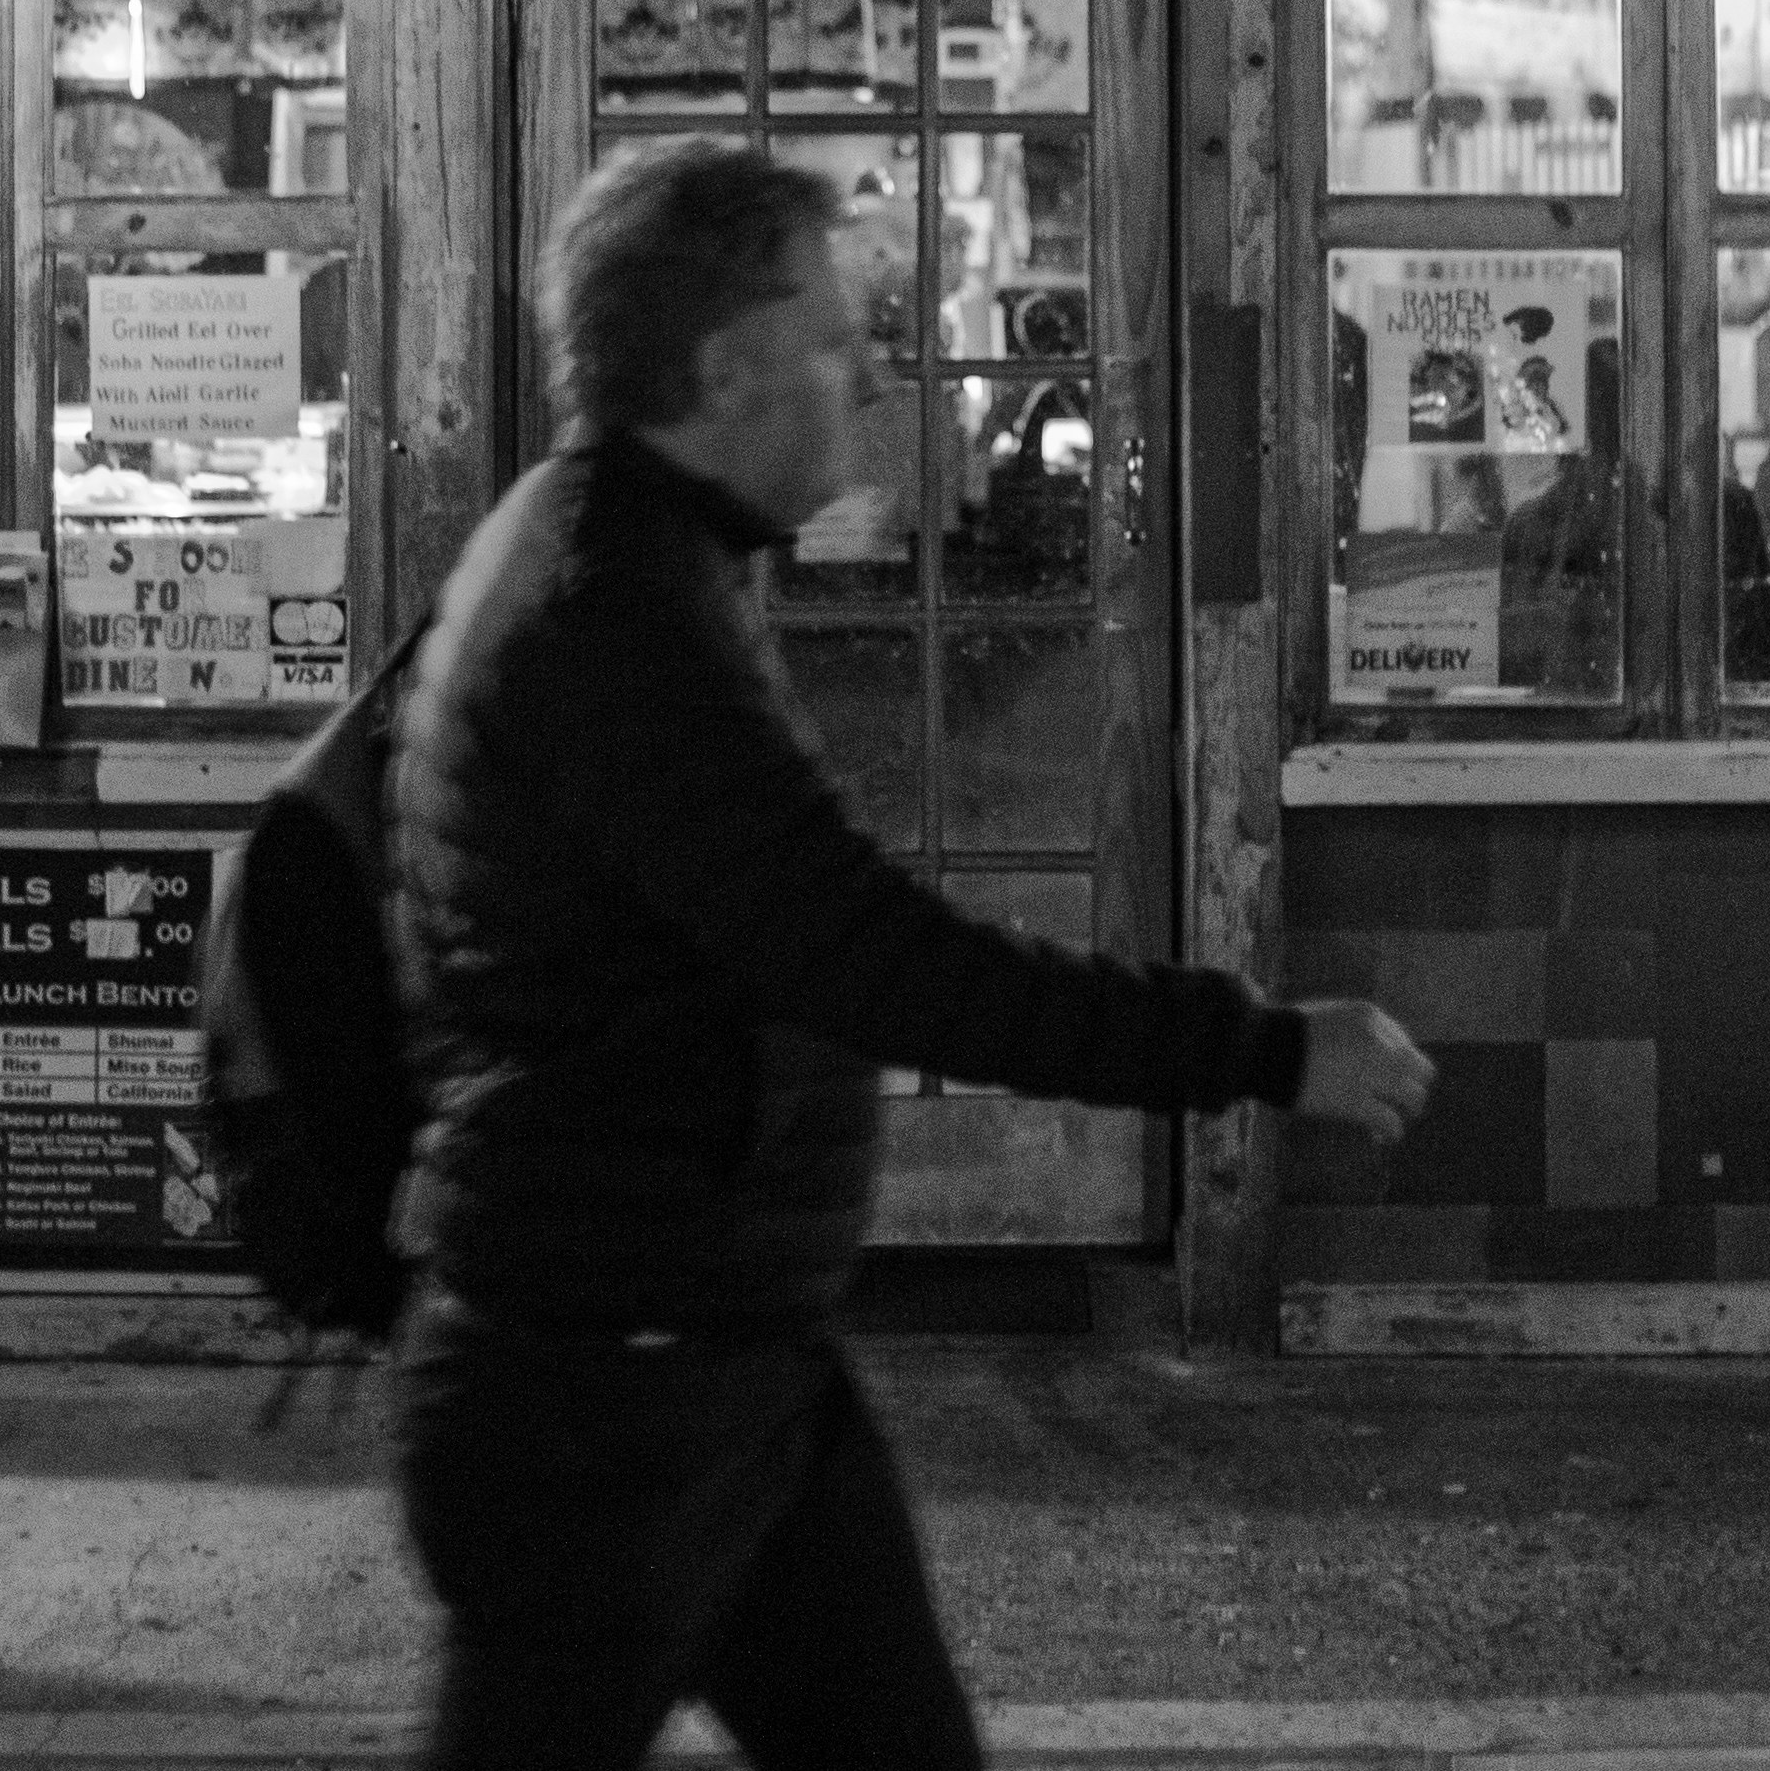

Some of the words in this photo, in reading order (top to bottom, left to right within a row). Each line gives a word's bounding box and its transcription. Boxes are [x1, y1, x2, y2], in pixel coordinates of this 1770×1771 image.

[1402, 289, 1490, 315] RAMEN
[112, 318, 179, 340] Grilled
[189, 322, 217, 339] Eel
[226, 322, 272, 339] Over
[98, 354, 142, 371] Soba
[150, 354, 216, 371] Noodle
[219, 353, 285, 371] Glazed
[96, 386, 139, 404] With
[146, 385, 190, 404] Aioli
[199, 384, 261, 403] Garlic
[109, 414, 189, 432] Mustard
[199, 413, 256, 432] Sauce
[1350, 644, 1471, 672] DELIVERY
[66, 655, 158, 695] DINE
[283, 666, 334, 685] VISA
[96, 981, 200, 1008] BENTO
[108, 1034, 174, 1049] Shumai
[2, 1058, 42, 1072] Rice
[108, 1059, 151, 1074] Miso
[156, 1059, 202, 1080] Soup
[2, 1082, 52, 1098] Salad
[107, 1083, 193, 1100] California
[49, 1113, 65, 1127] of
